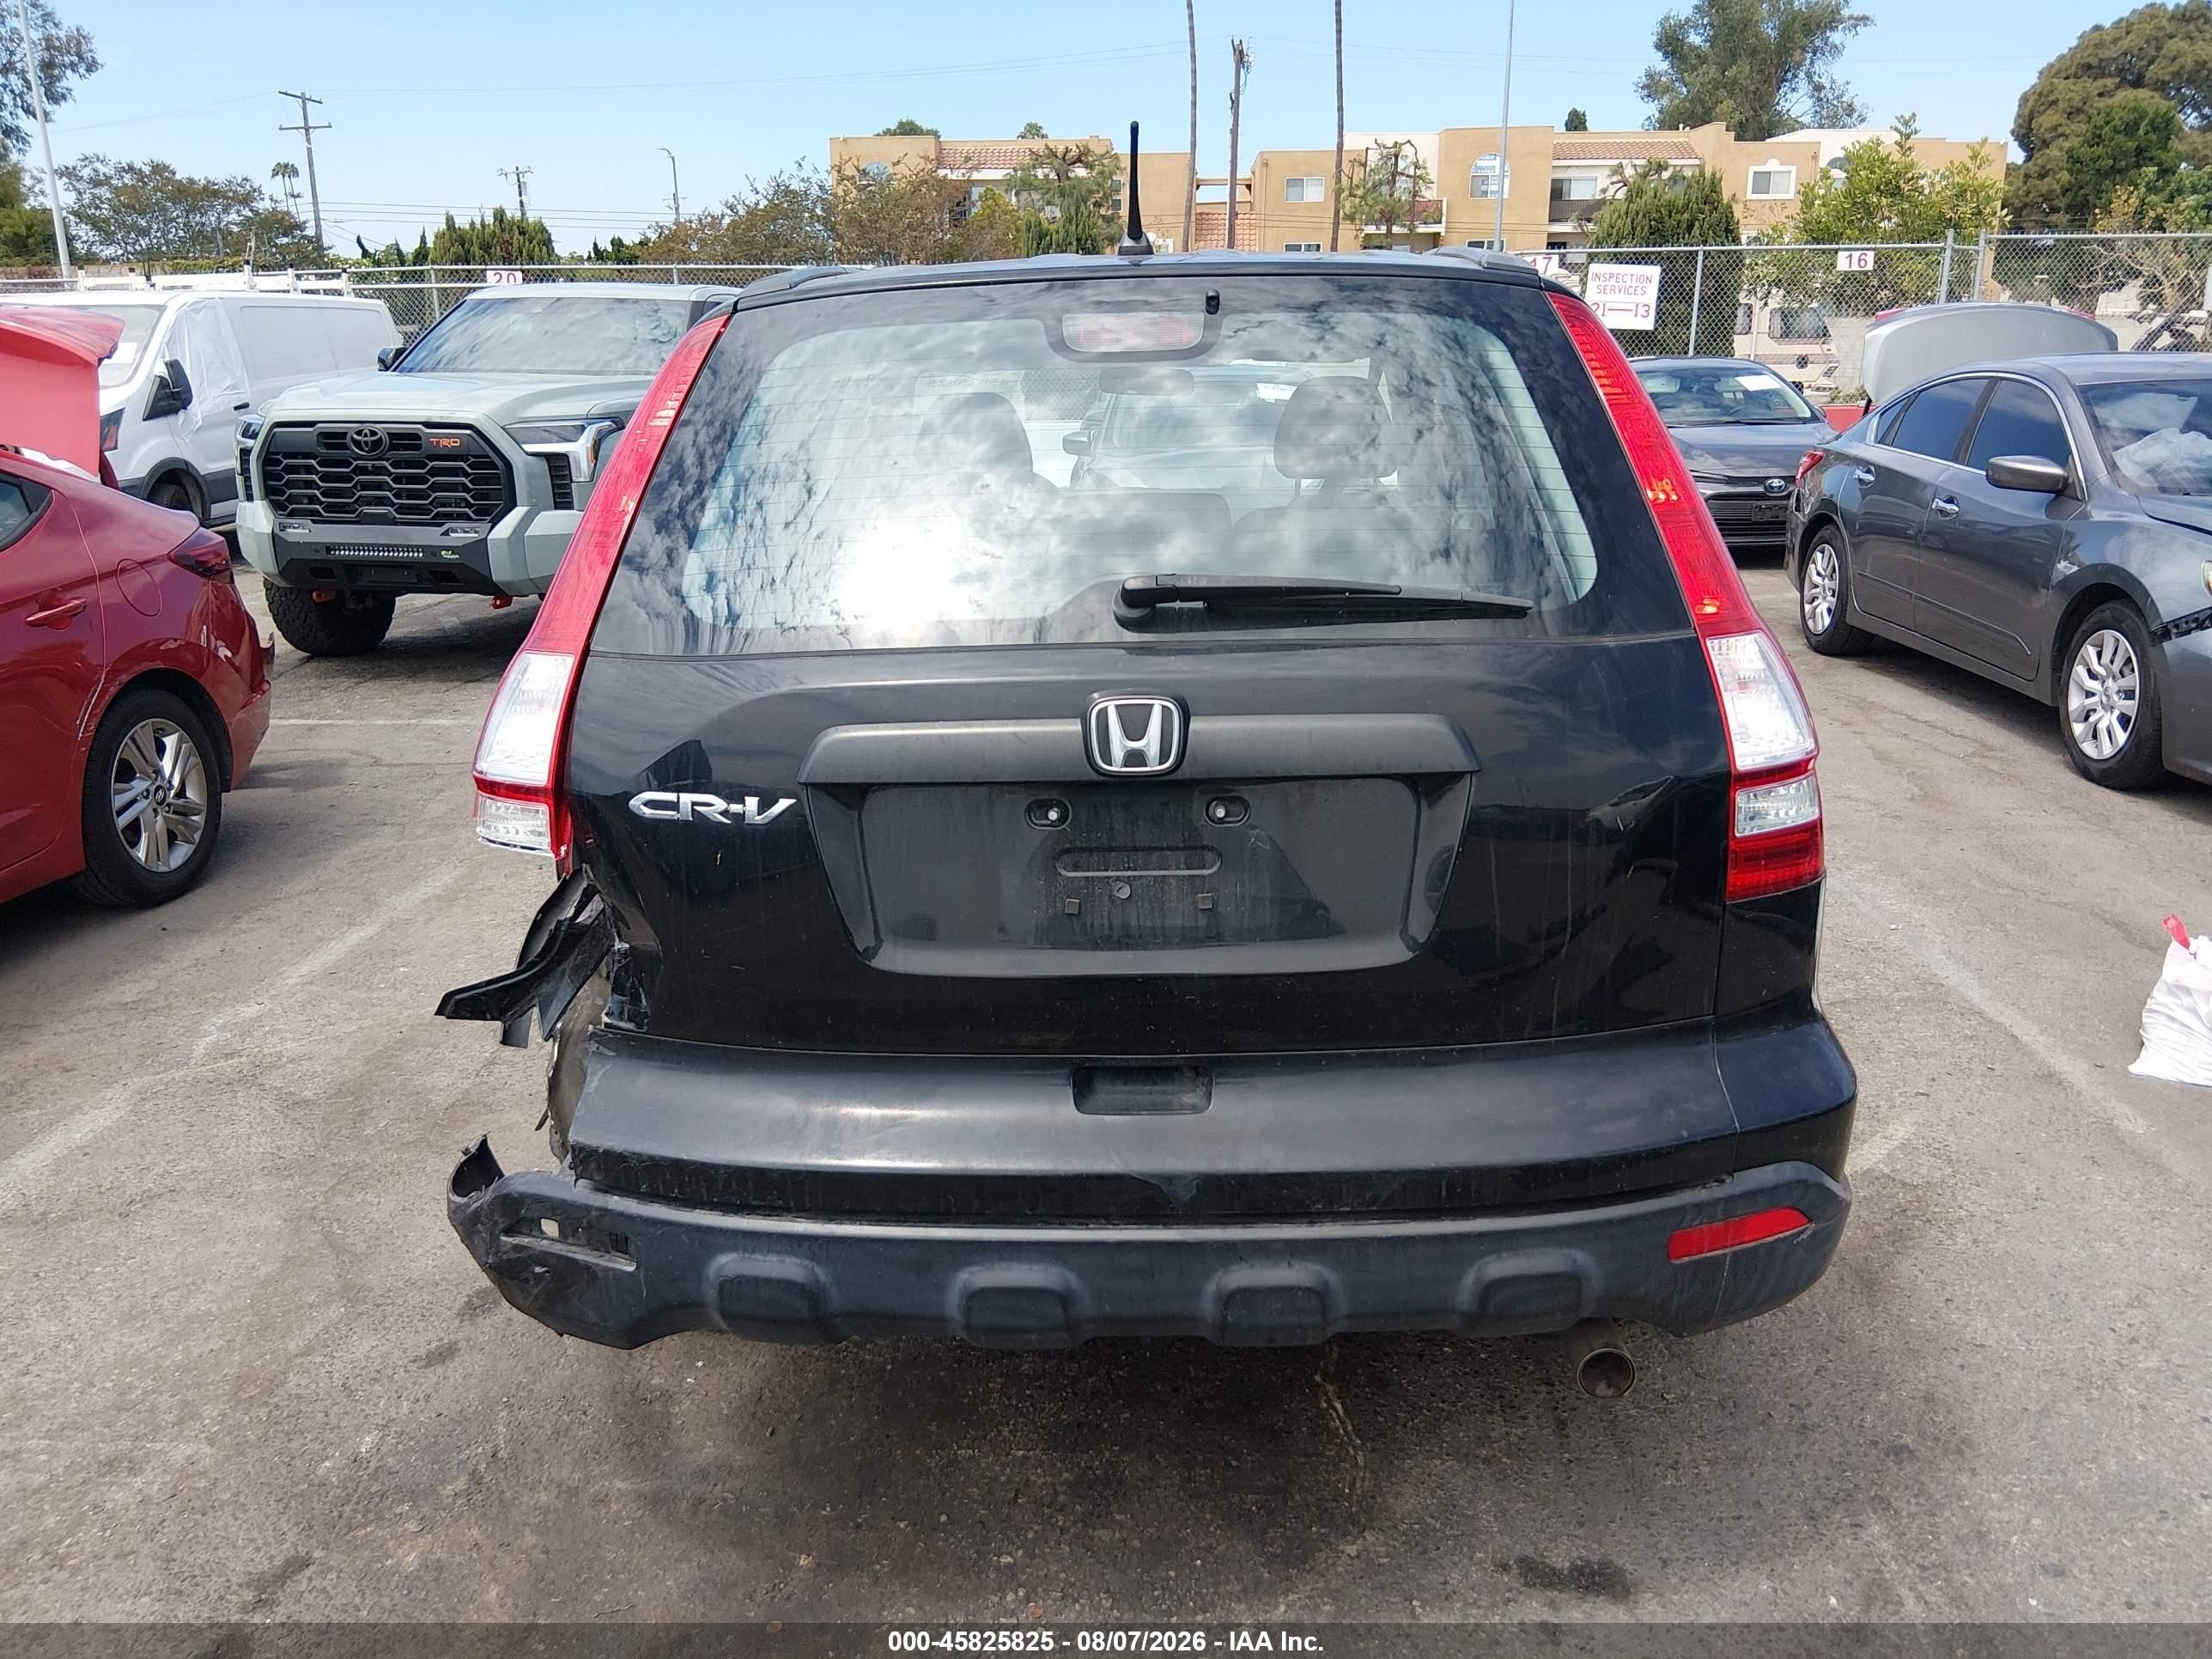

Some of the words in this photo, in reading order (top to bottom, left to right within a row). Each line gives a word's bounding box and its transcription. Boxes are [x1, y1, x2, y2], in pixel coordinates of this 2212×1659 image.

[1844, 252, 1868, 269] 16
[1590, 271, 1654, 284] INSPECTION
[1596, 284, 1647, 295] SERVICES
[429, 438, 460, 448] TRD
[628, 791, 797, 824] CR-V
